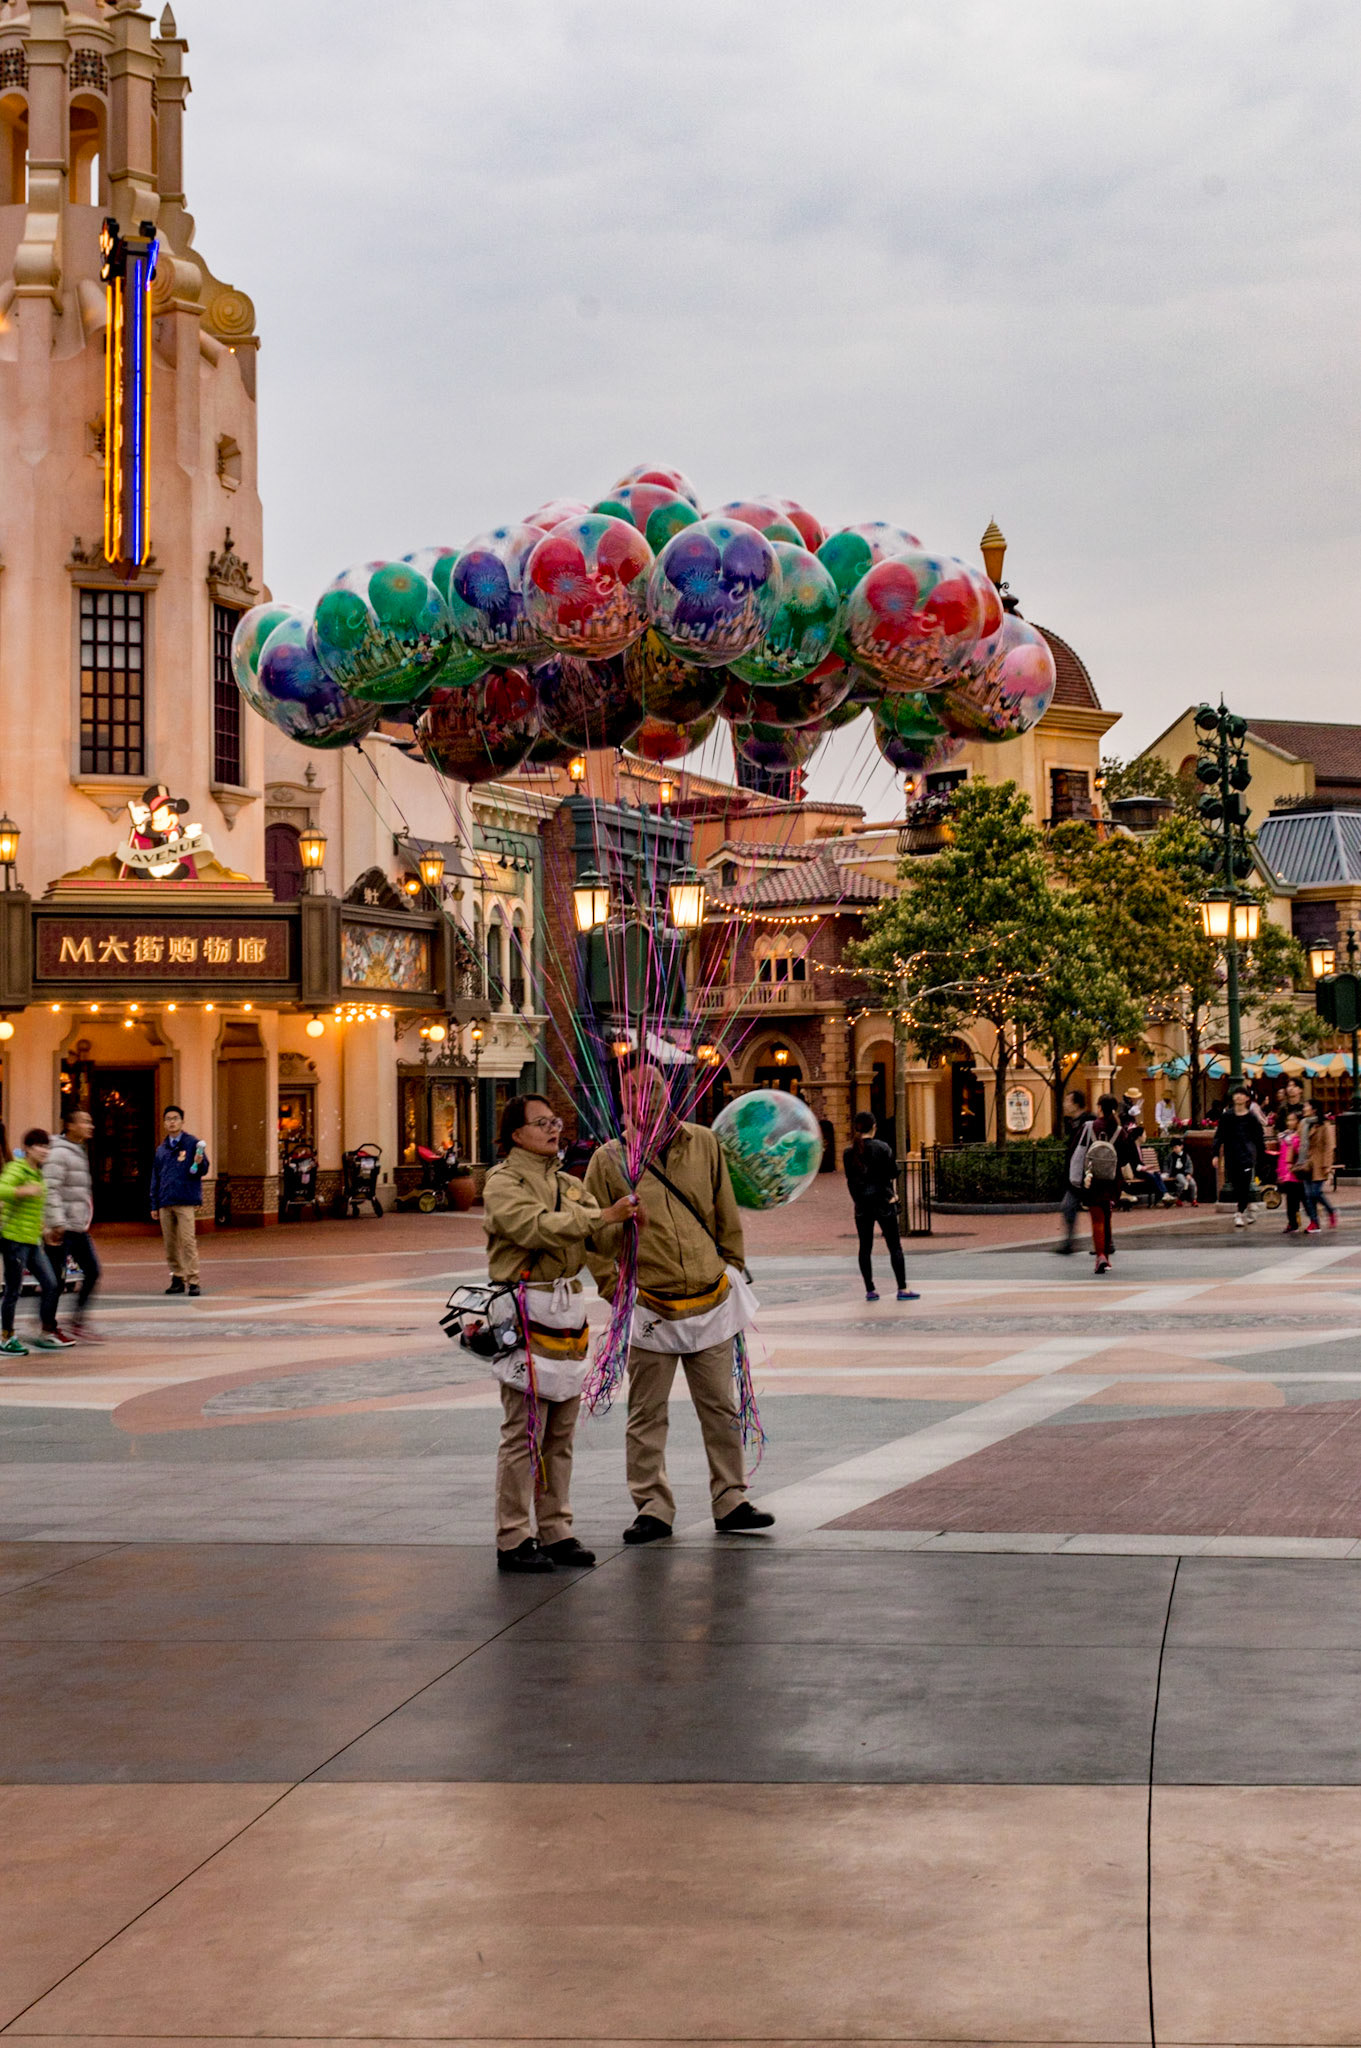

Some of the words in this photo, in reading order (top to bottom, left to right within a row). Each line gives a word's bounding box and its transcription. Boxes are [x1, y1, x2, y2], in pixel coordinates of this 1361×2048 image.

[131, 839, 201, 863] AVENUE
[59, 935, 268, 963] M大街购物廊
